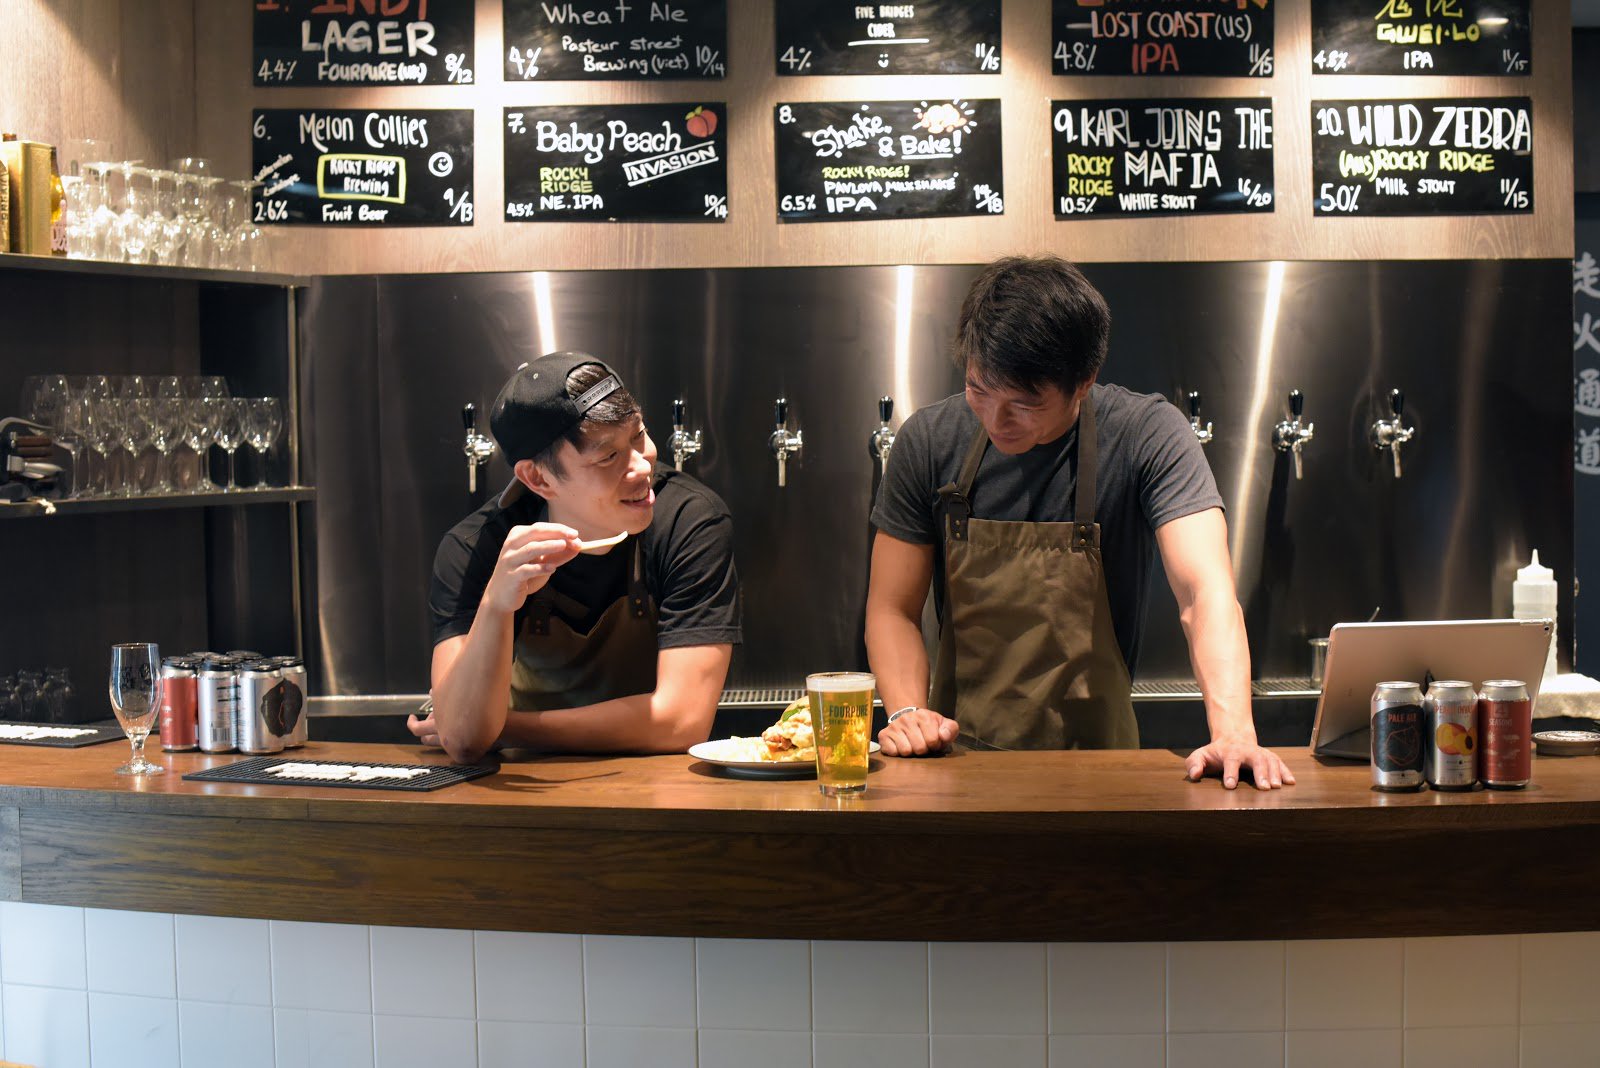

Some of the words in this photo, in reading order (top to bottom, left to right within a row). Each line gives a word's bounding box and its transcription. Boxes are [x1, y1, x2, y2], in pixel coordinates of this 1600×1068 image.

[541, 0, 632, 25] Wheat
[650, 4, 689, 23] Ale
[855, 5, 875, 19] FIVE
[302, 20, 437, 57] LAGER
[867, 22, 895, 38] CIDER
[562, 35, 620, 53] Pasteur
[630, 35, 683, 50] street
[509, 46, 542, 79] 4%
[584, 55, 648, 75] Brewing
[780, 46, 812, 71] 4%
[1054, 41, 1097, 71] 4.8%
[1132, 42, 1180, 74] IPA
[1403, 51, 1434, 69] IPA
[258, 59, 297, 81] 4.4%
[299, 113, 354, 153] Melon
[364, 112, 428, 148] Collies
[1080, 108, 1140, 148] KARL
[1145, 108, 1222, 150] JOINS
[1234, 108, 1272, 150] THE
[1347, 104, 1423, 146] WILD
[1429, 106, 1532, 153] ZEBRA
[536, 121, 604, 164] Baby
[607, 120, 681, 153] Peach
[878, 136, 896, 158] &
[900, 130, 962, 154] Bake!
[624, 145, 716, 181] INVASION
[1068, 154, 1114, 177] ROCKY
[1124, 150, 1222, 189] MAFIA
[1439, 150, 1495, 172] RIDGE
[540, 167, 588, 181] ROCKY
[822, 166, 865, 179] ROCKY
[344, 177, 389, 197] Brewing
[541, 180, 593, 193] RIDGE
[1068, 179, 1114, 196] RIDGE
[1416, 179, 1456, 195] STOUT
[254, 200, 288, 221] 2.6%
[781, 194, 816, 211] 6.5%
[826, 196, 878, 214] IPA
[1061, 196, 1097, 214] 10.5%
[1118, 193, 1158, 210] WHITE
[1161, 194, 1197, 210] STOUT
[322, 203, 353, 222] Fruit
